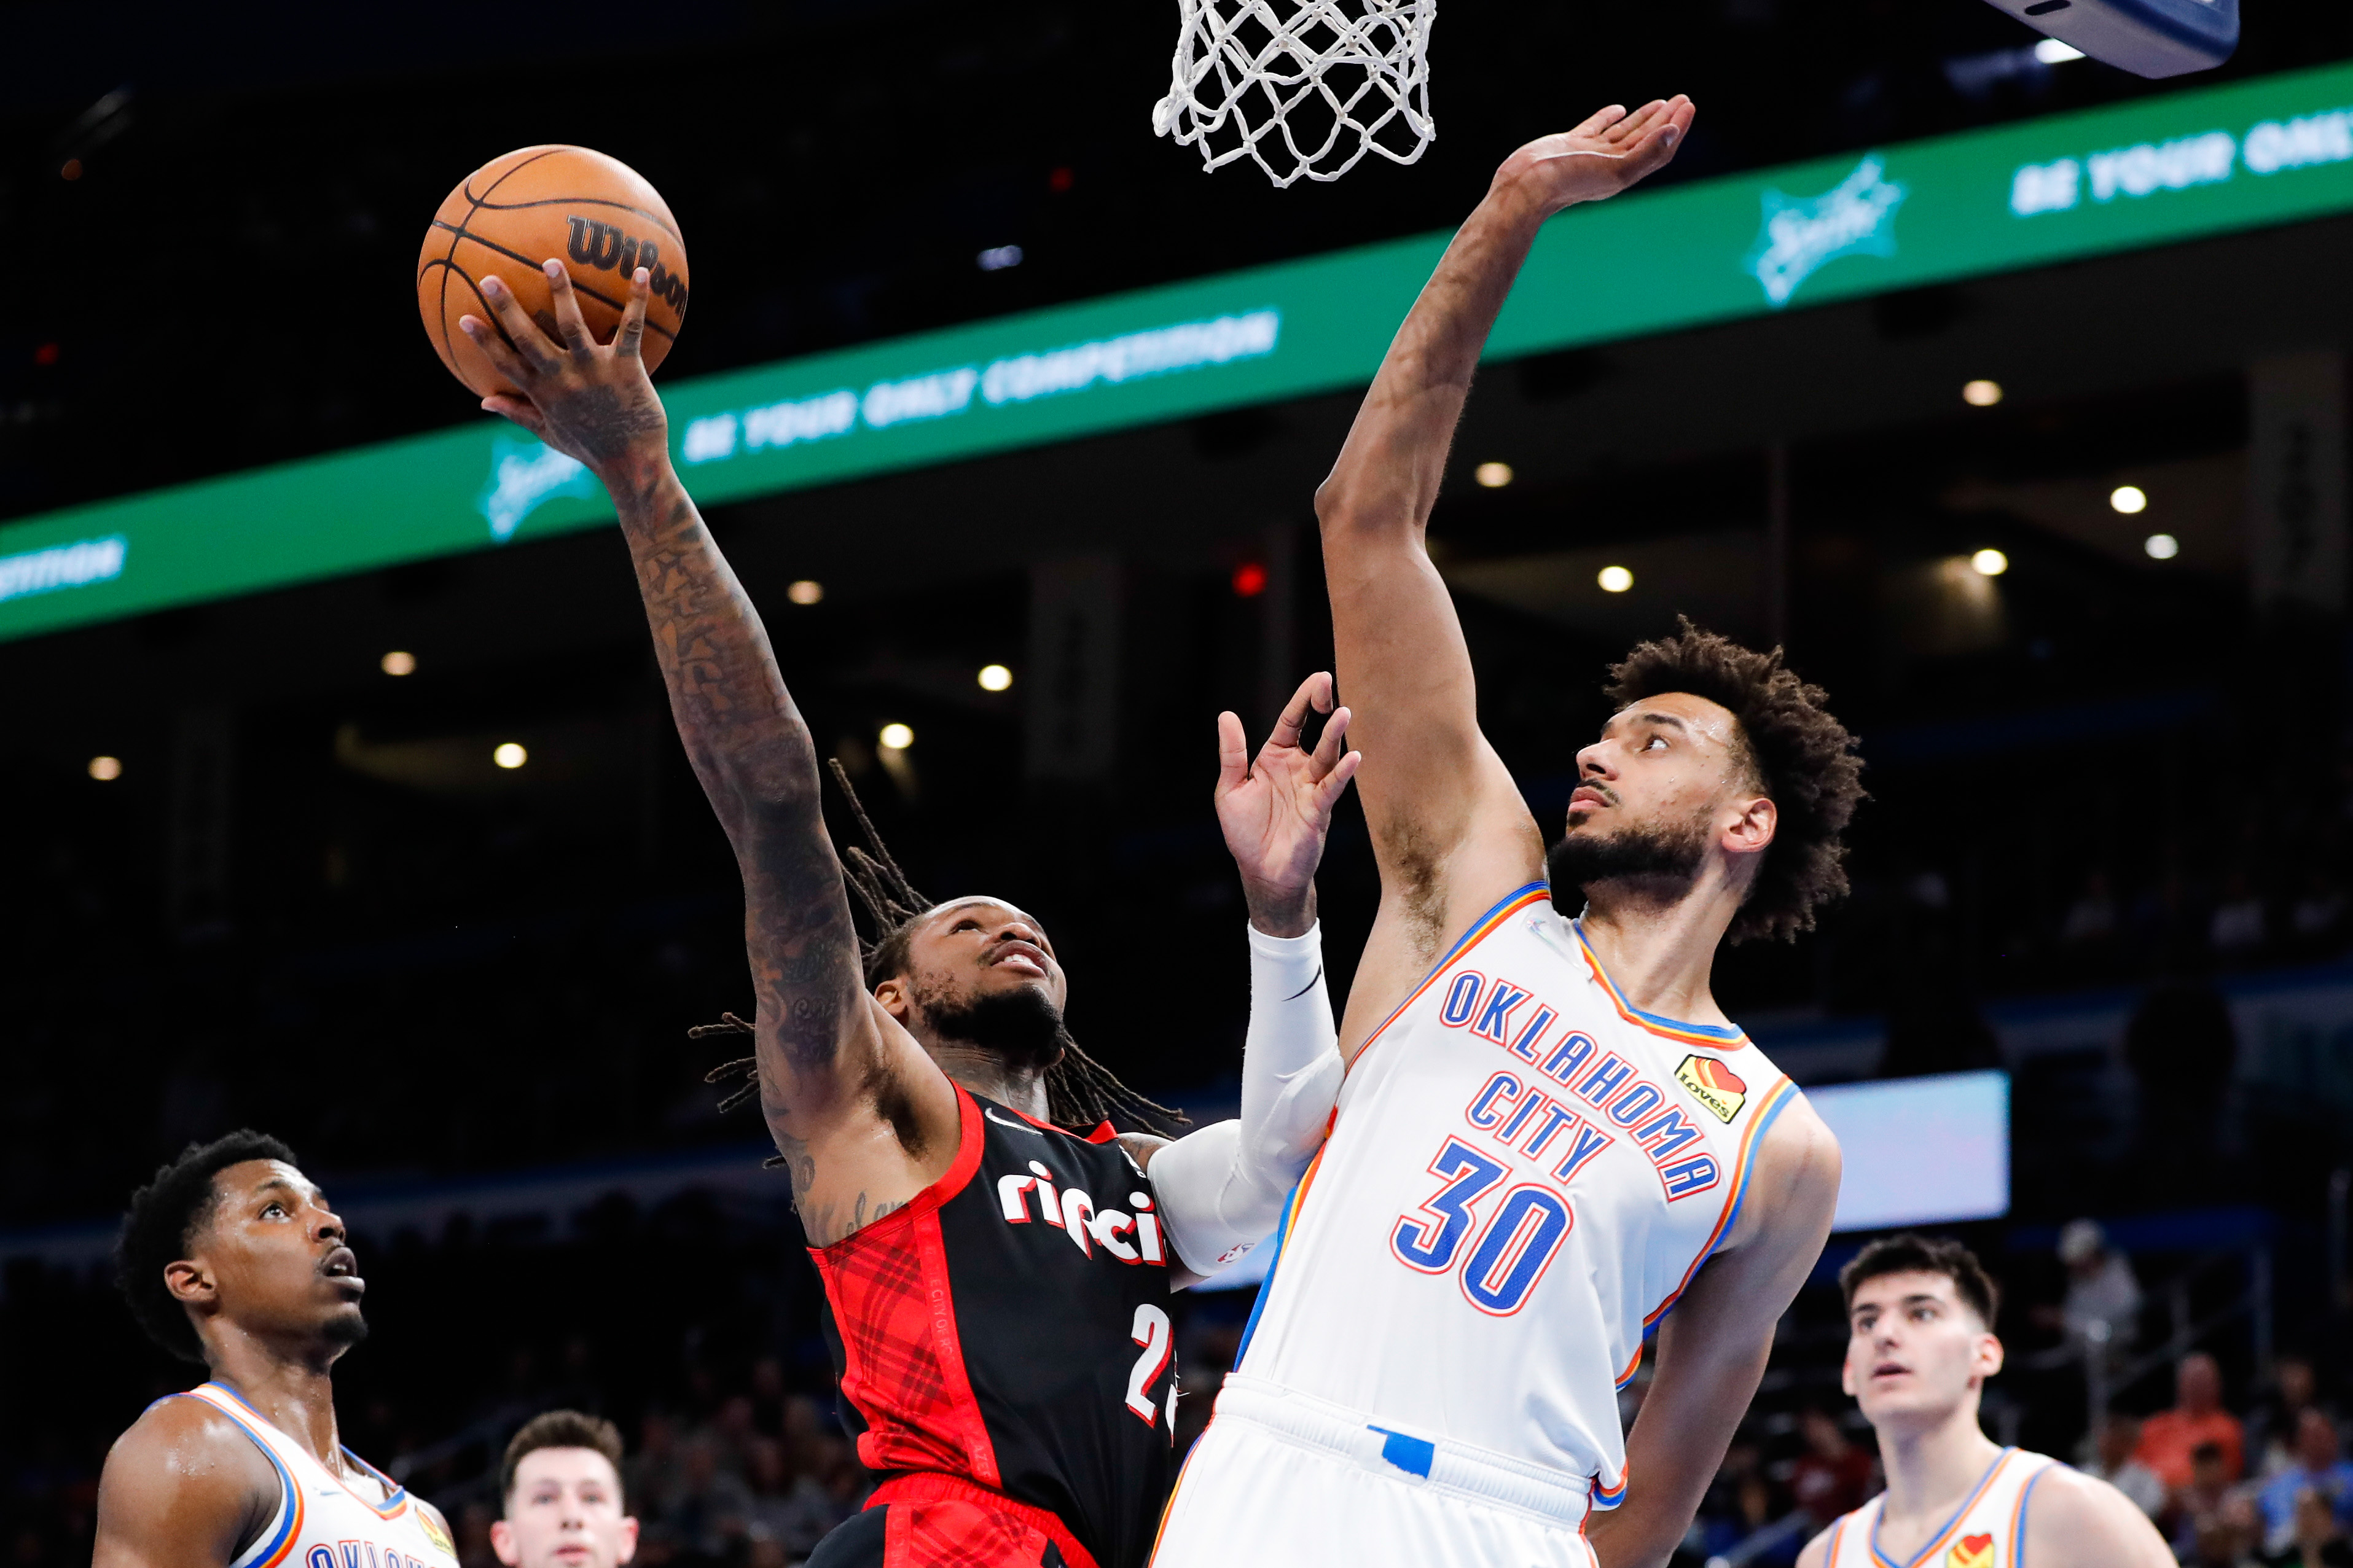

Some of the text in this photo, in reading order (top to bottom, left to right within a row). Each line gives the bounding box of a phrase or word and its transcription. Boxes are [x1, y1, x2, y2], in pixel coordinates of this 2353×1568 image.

[2243, 112, 2353, 173] ONL
[1439, 970, 1721, 1202] OKLAHOMA
[1465, 1071, 1615, 1185] CITY
[997, 1160, 1167, 1266] ripci
[1390, 1134, 1573, 1317] 30
[1126, 1303, 1179, 1448] 2
